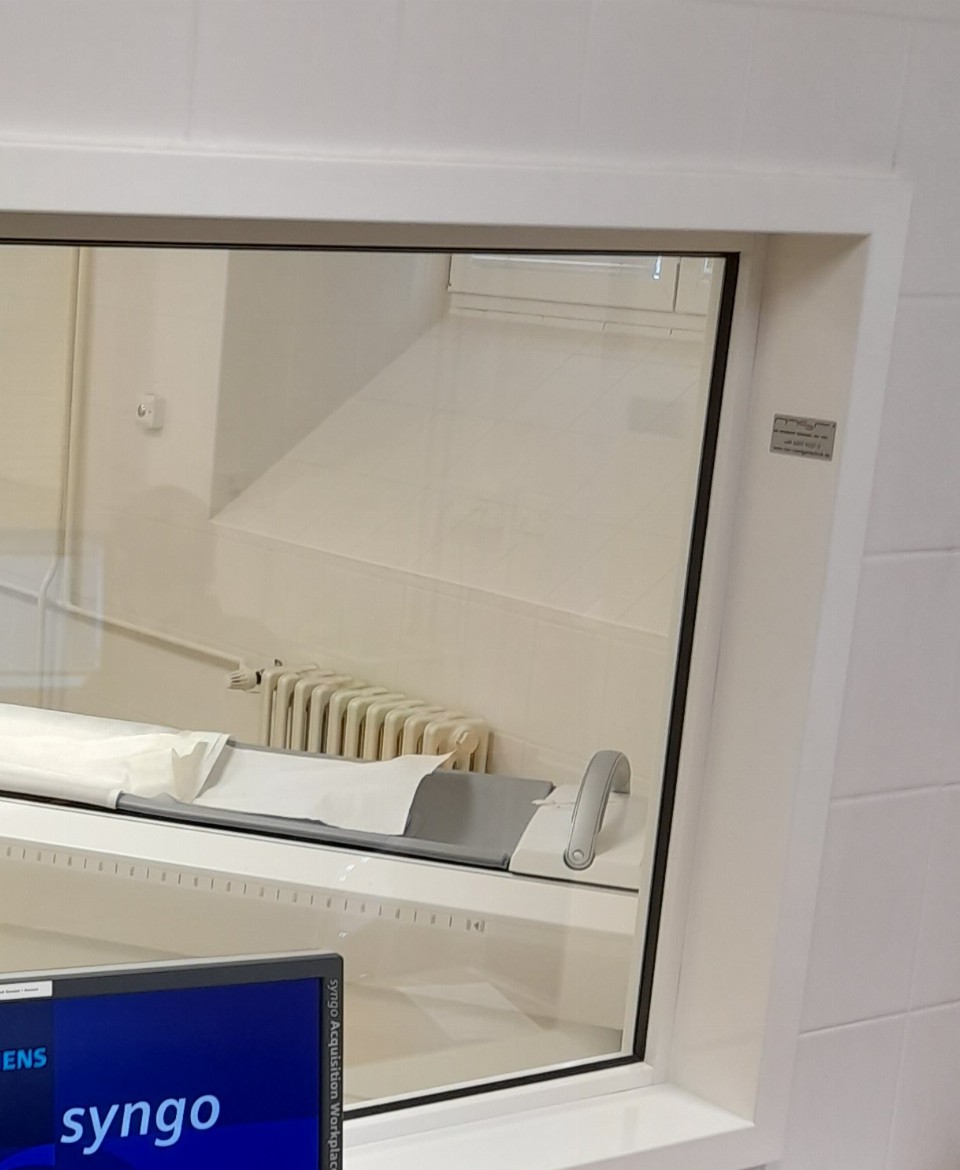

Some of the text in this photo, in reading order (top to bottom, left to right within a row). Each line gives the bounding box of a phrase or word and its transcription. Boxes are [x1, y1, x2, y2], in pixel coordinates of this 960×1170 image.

[327, 979, 339, 1018] syngo
[328, 1021, 342, 1100] Acquisition
[60, 1094, 220, 1155] syngo
